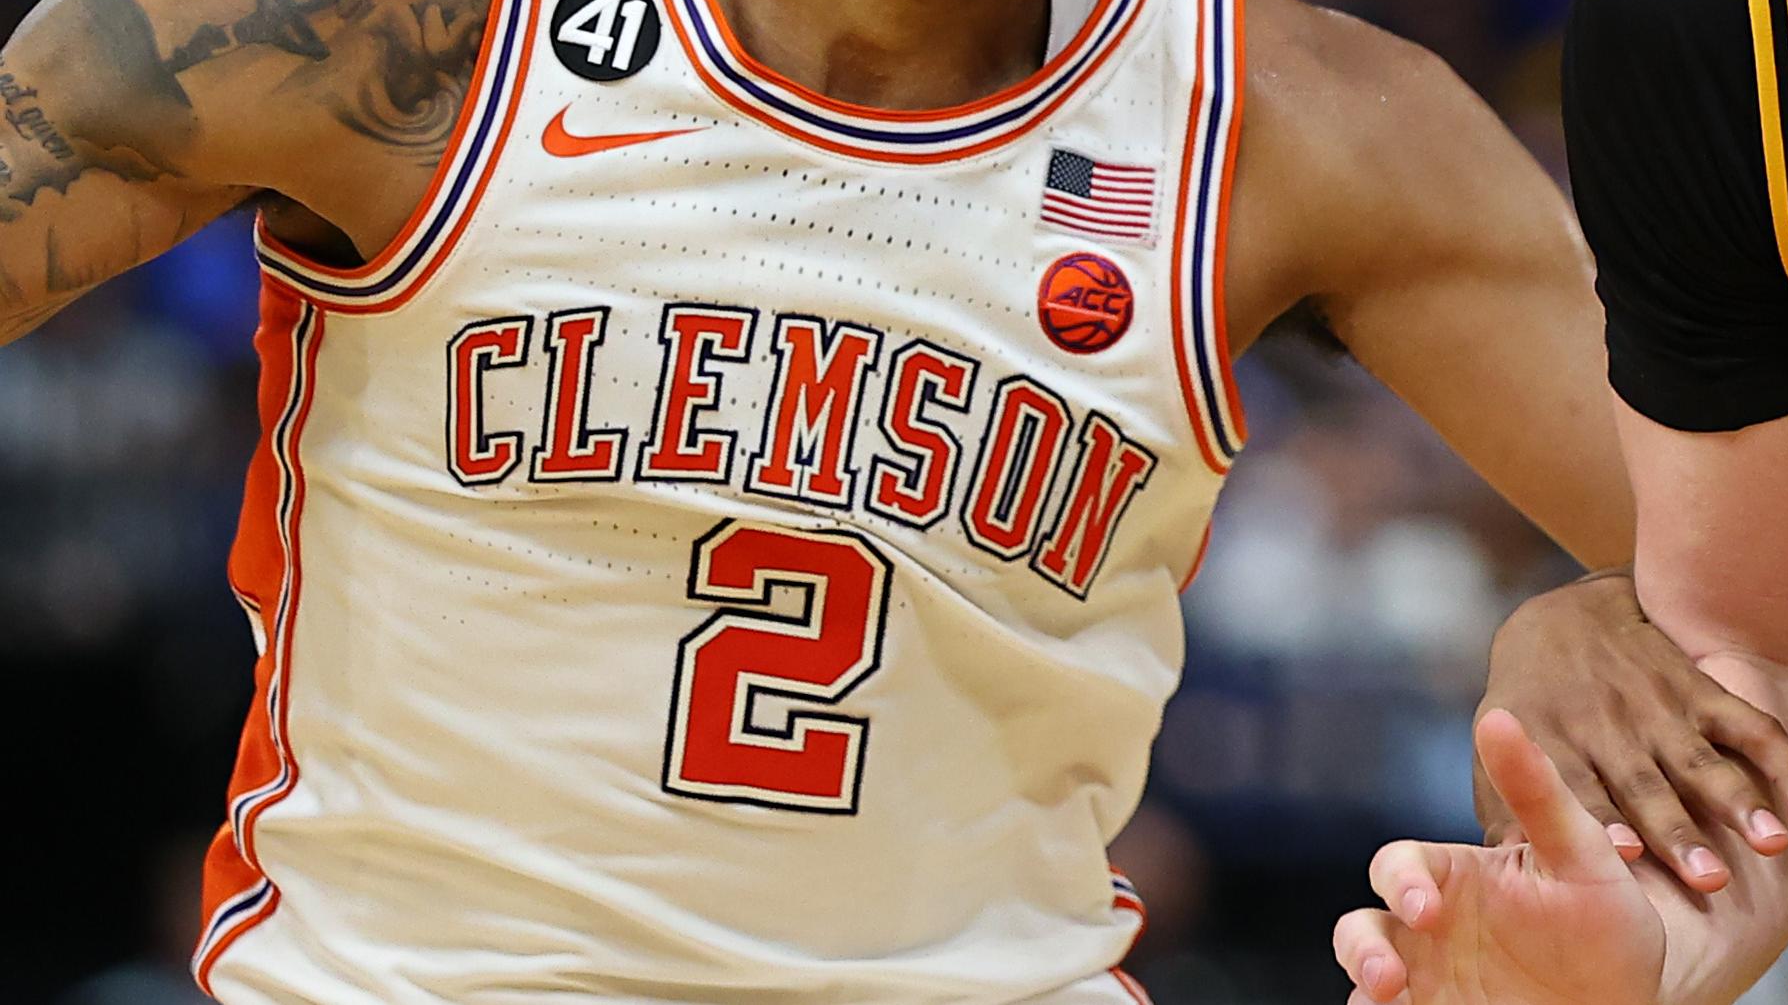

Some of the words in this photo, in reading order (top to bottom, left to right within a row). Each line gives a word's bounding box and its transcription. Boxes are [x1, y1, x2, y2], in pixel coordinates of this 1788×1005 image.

[1054, 286, 1126, 315] ACC
[446, 302, 1159, 601] CLEMSON
[662, 516, 894, 815] 2
